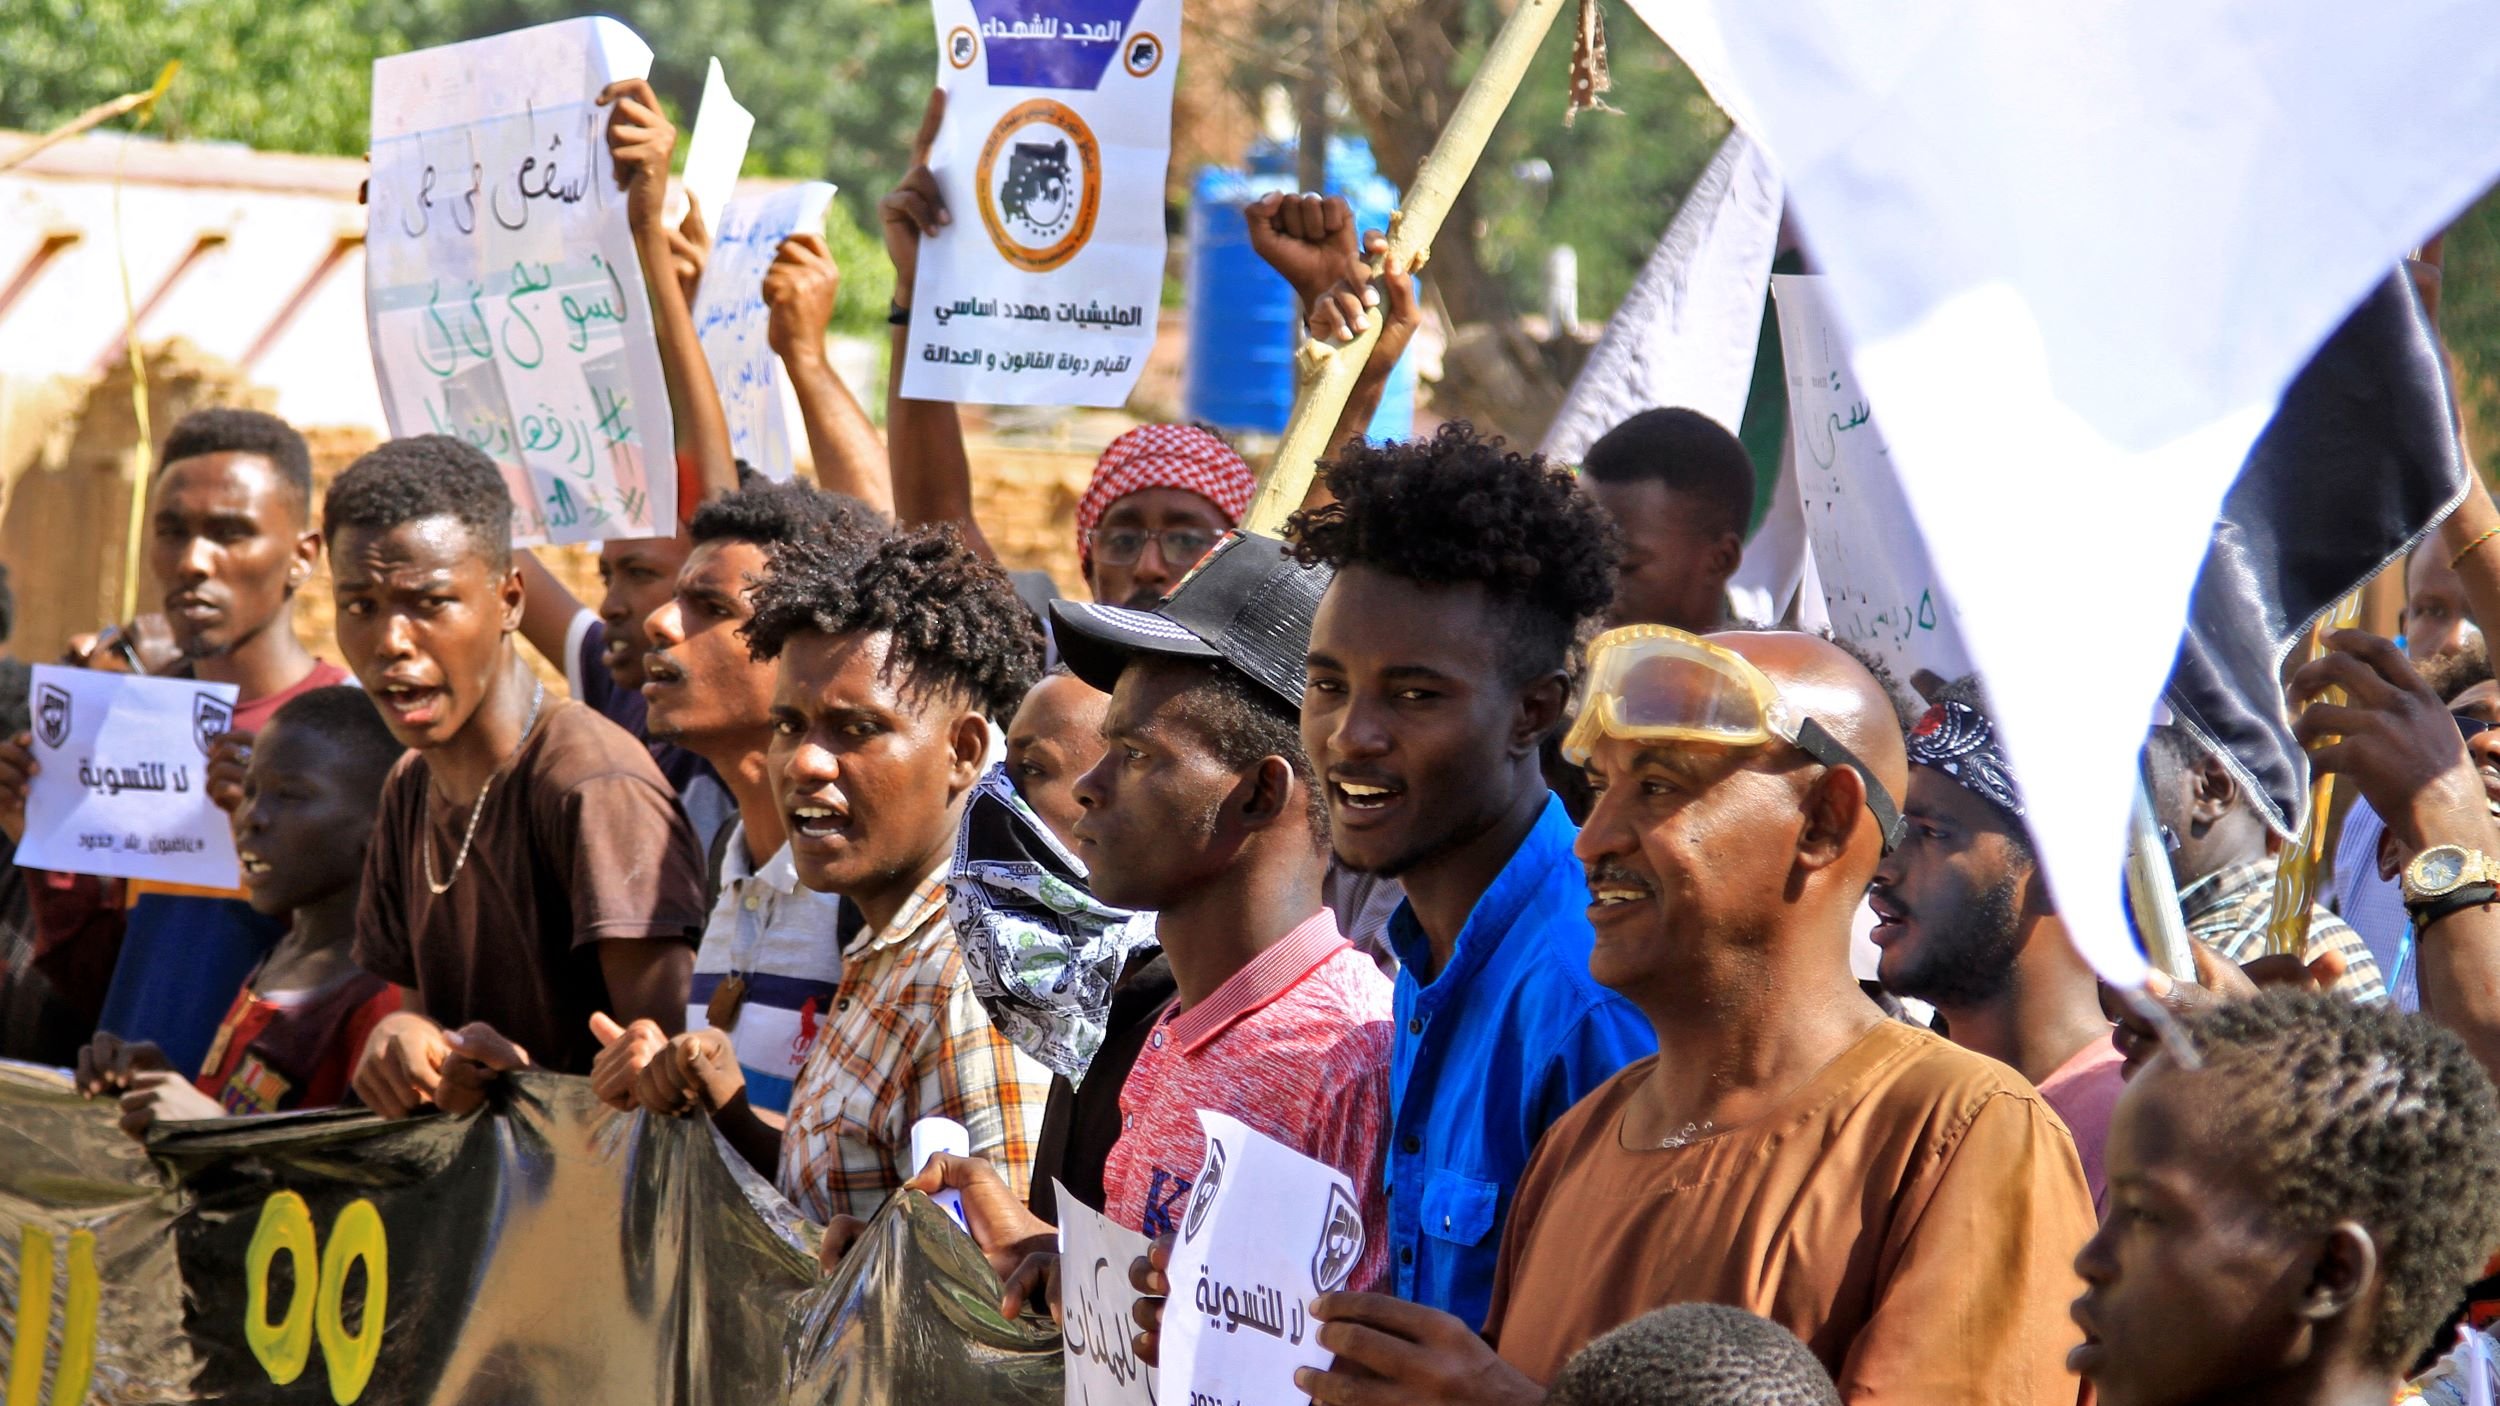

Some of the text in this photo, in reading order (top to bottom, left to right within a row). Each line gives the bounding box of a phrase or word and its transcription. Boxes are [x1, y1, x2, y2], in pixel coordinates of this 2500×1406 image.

[983, 17, 1122, 47] المجد للشهداء
[1004, 301, 1050, 322] مهدد
[1057, 299, 1142, 329] المليشيات
[923, 343, 1131, 377] لقيام دولة القانون و العدالة
[78, 757, 189, 795] لا للتسوية
[1195, 1264, 1306, 1347] لا للتسوية
